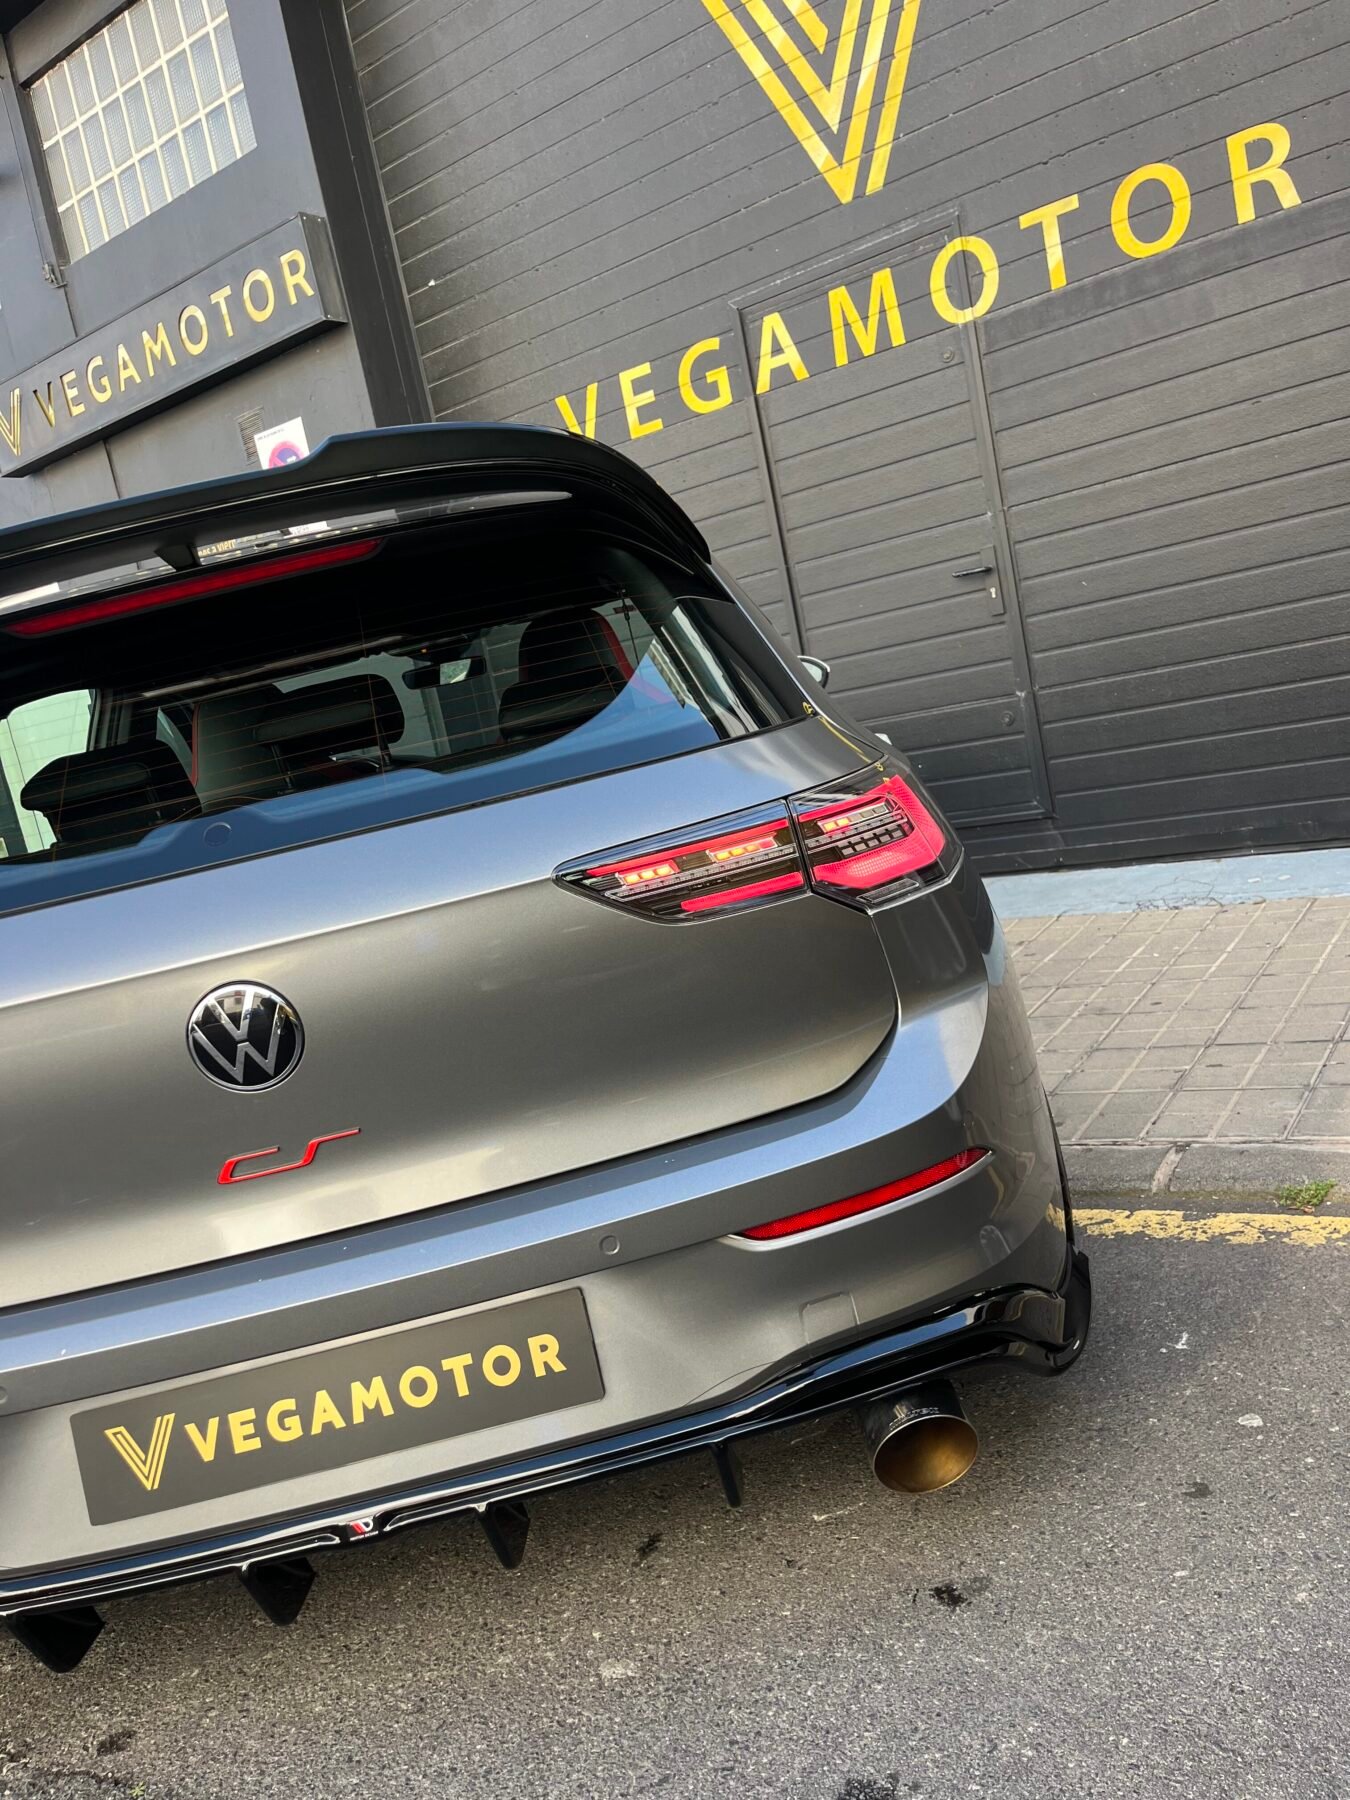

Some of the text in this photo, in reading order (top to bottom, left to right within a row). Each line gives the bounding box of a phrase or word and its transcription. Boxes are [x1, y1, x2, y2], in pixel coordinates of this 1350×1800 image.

[33, 249, 316, 428] VEGAMOTOR
[554, 122, 1303, 442] VEGAMOTOR
[184, 1332, 568, 1463] VEGAMOTOR
